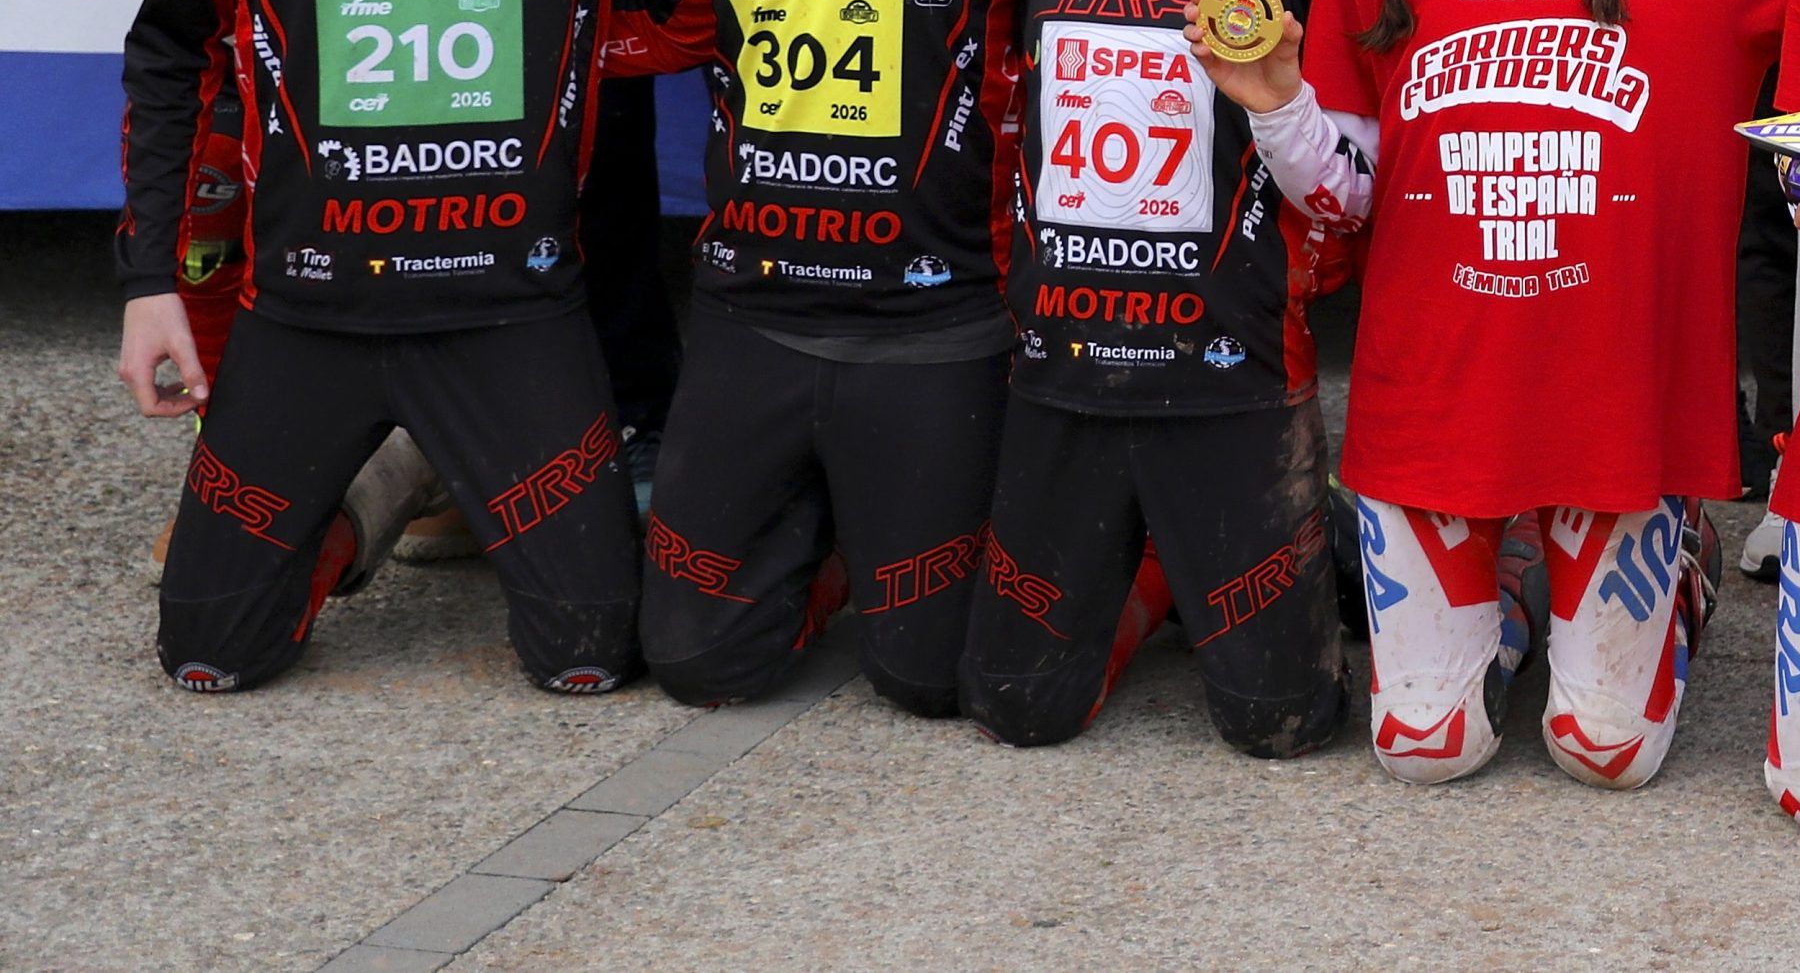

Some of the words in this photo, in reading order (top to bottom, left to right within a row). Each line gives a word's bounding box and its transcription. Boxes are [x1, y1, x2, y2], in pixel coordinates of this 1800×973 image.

[346, 21, 495, 84] 210
[747, 30, 881, 93] 304
[1091, 47, 1193, 84] SPEA
[450, 90, 492, 109] 2026
[830, 103, 868, 122] 2026
[1055, 89, 1093, 109] rfme
[365, 137, 524, 175] BADORC
[753, 149, 898, 187] BADORC
[1050, 118, 1194, 187] 407
[1438, 130, 1602, 173] CAMPEONA
[1138, 197, 1180, 216] 2026
[1446, 174, 1476, 216] DE
[1482, 171, 1598, 217] ESPAÑA
[323, 192, 527, 235] MOTRIO
[722, 199, 902, 245] MOTRIO
[300, 248, 331, 267] Tiro
[711, 241, 736, 261] Tiro
[1066, 233, 1199, 271] BADORC
[1478, 219, 1559, 262] TRIAL
[391, 250, 495, 273] Tractermia
[777, 260, 873, 281] Tractermia
[1452, 262, 1540, 297] FÉMINA
[1546, 262, 1590, 291] TR1
[1034, 284, 1206, 326] MOTRIO
[1087, 342, 1176, 361] Tractermia
